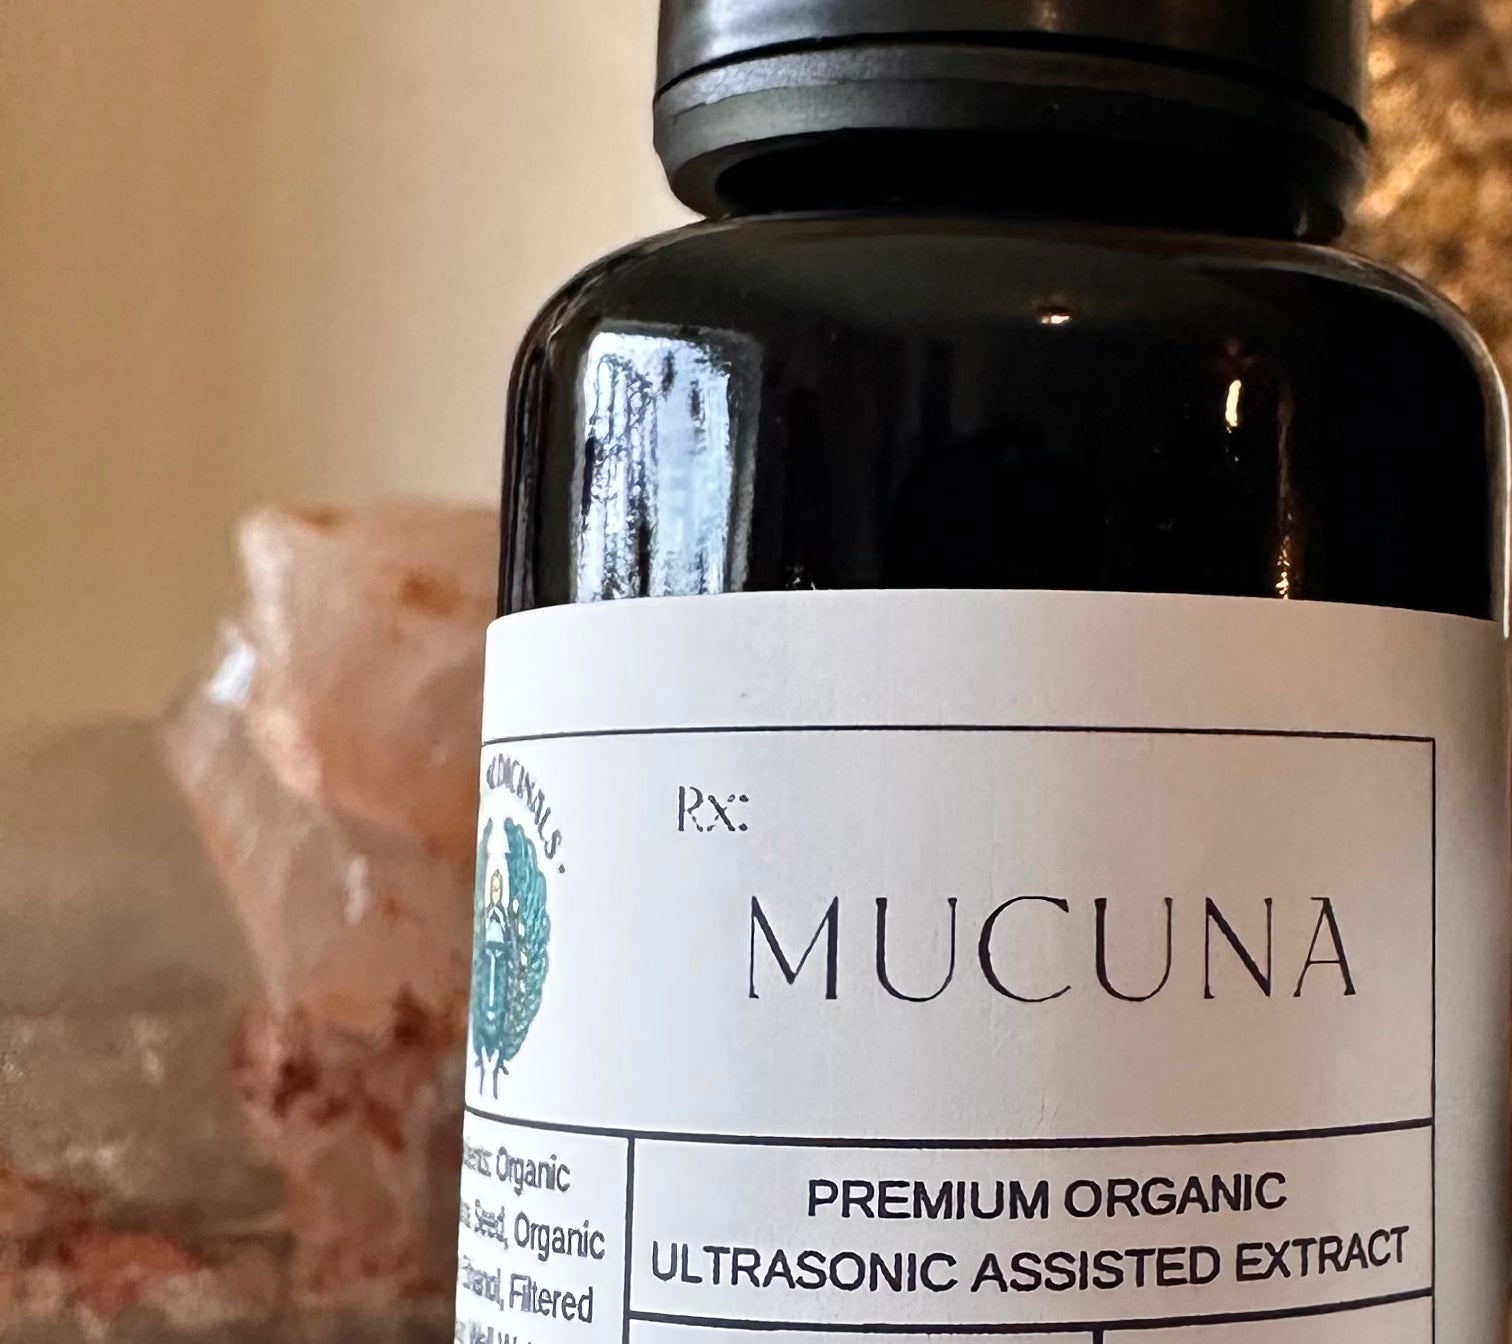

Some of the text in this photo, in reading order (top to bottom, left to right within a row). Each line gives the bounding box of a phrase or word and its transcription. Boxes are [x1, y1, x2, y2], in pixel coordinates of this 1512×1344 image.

[677, 785, 750, 833] Rx:
[747, 895, 1357, 1004] MUCUNA
[496, 1145, 571, 1197] Organic
[807, 1171, 1288, 1221] PREMIUM ORGANIC
[514, 1211, 606, 1263] Organic
[651, 1225, 1411, 1293] ULTRASONIC ASSISTED EXTRACT
[509, 1272, 594, 1324] Filtered
